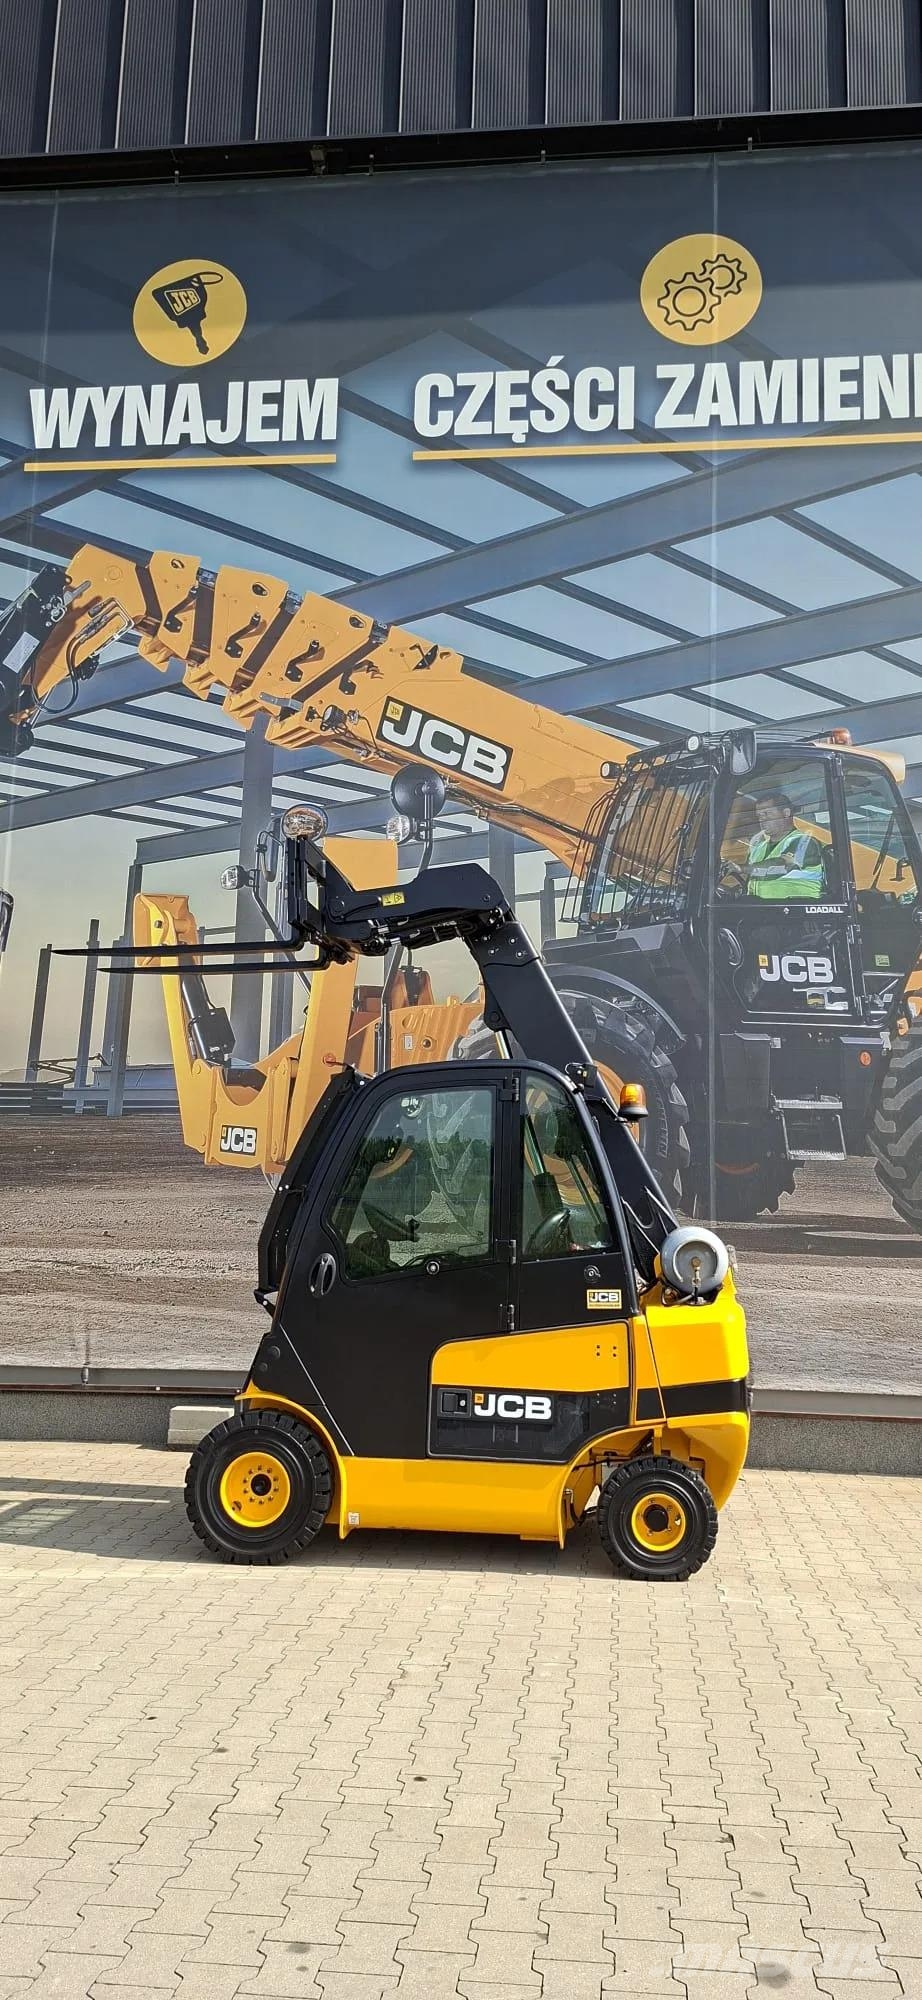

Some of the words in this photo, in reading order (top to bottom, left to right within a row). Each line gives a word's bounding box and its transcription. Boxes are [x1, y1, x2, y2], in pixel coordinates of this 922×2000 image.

[171, 290, 198, 312] JCB
[413, 355, 635, 443] CZĘŚCI
[29, 378, 339, 449] WYNAJEM
[381, 710, 507, 784] JCB
[805, 906, 844, 914] LOADALL
[759, 955, 834, 983] JCB
[220, 1127, 257, 1153] JCB
[590, 1292, 619, 1302] JCB
[474, 1393, 552, 1420] JCB
